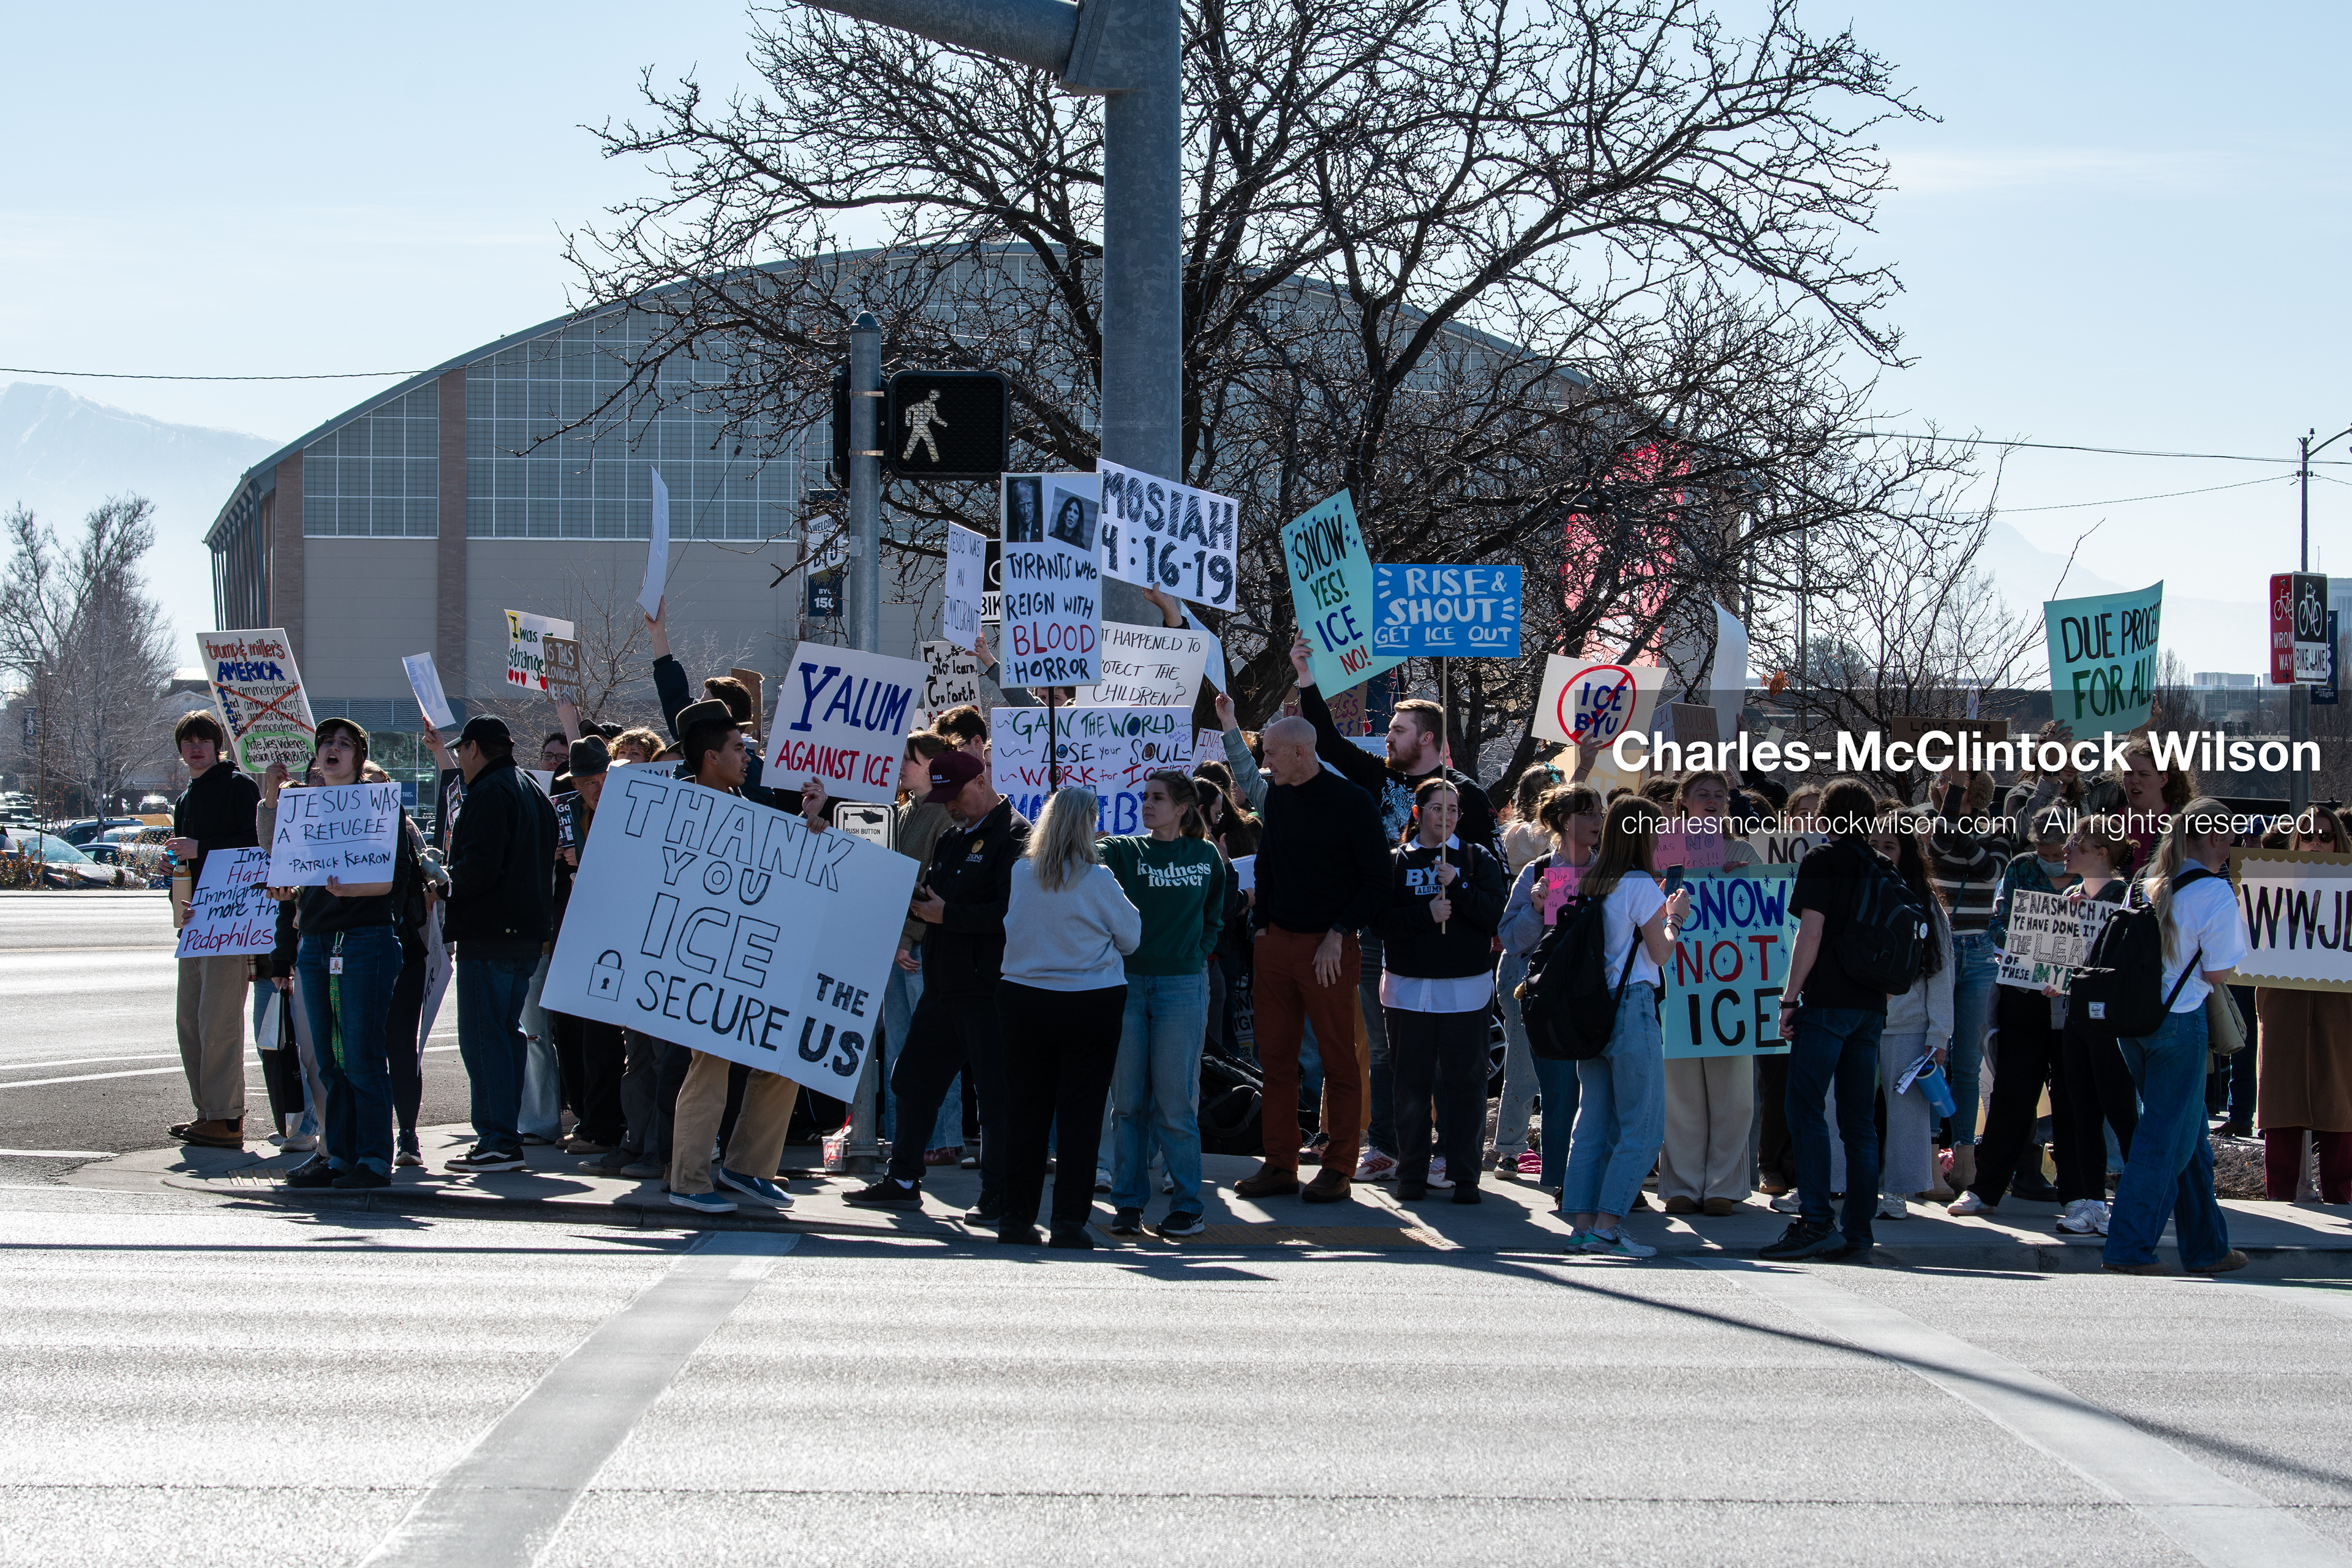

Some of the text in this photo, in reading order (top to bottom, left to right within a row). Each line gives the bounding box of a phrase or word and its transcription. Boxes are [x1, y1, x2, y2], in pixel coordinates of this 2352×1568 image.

[1102, 469, 1234, 550] MOSIAH
[949, 531, 981, 558] JESUS WAS
[1294, 513, 1347, 582] SNOW
[956, 568, 965, 587] AN
[1006, 552, 1098, 582] TYRANTS WHO
[1310, 568, 1349, 610] YES!
[1406, 567, 1507, 597] RISE &
[944, 595, 981, 636] IMMIGRANT
[982, 596, 1001, 616] BIK
[1005, 592, 1094, 621] REIGN WITH
[1384, 597, 1499, 625] SHOUT
[508, 614, 519, 639] I
[519, 627, 538, 643] was
[1012, 621, 1095, 656] BLOOD
[1113, 629, 1183, 650] HAPPENED
[1188, 637, 1201, 653] TO
[1314, 604, 1363, 652] ICE
[1374, 626, 1512, 645] GET ICE OUT
[2060, 612, 2116, 663] DUE
[2273, 631, 2293, 648] WRON
[205, 640, 238, 662] trump
[247, 639, 285, 660] miller's
[545, 643, 575, 666] IS THIS
[924, 646, 978, 675] Enter learn,
[1339, 644, 1372, 676] NO!
[2278, 654, 2293, 670] WAY
[2296, 648, 2309, 671] BIKE
[2311, 649, 2326, 672] LANE
[217, 661, 286, 682] AMERICA
[568, 668, 579, 684] OUR
[1014, 657, 1090, 684] HORROR
[1102, 658, 1180, 680] OTECT THE
[238, 680, 299, 698] ammendment
[790, 662, 913, 736] YALUM
[925, 674, 976, 707] Go Forth
[1580, 682, 1627, 711] ICE
[2072, 654, 2152, 720] FOR ALL
[244, 696, 304, 714] ammendment
[247, 710, 305, 726] ammendment
[1675, 707, 1712, 730] YOU CAN
[252, 721, 309, 736] ammendment
[1081, 712, 1107, 737] THE
[1108, 712, 1175, 739] WORLD
[1574, 710, 1618, 738] BYU
[1910, 721, 1991, 734] LOVE YOUR
[245, 751, 269, 763] division
[774, 739, 860, 781] AGAINST
[1041, 739, 1191, 765] LOSE your SOUL
[862, 753, 894, 788] ICE
[1019, 765, 1118, 786] WORK for
[284, 787, 399, 823] JESUS WAS
[277, 818, 388, 844] A REFUGEE
[625, 780, 854, 892] THANK
[1685, 834, 1714, 851] NO
[344, 850, 391, 867] KEARON
[1768, 837, 1810, 864] NO
[663, 846, 771, 906] YOU
[1137, 858, 1211, 879] kindness
[1148, 874, 1203, 887] forever
[1547, 870, 1570, 883] Due
[206, 902, 249, 921] more
[1680, 879, 1784, 932] SNOW
[2014, 891, 2097, 921] INASMUCH
[184, 918, 274, 952] Pedophiles
[2013, 914, 2026, 931] YE
[2026, 916, 2049, 932] HAVE
[2052, 919, 2079, 938] DONE
[2082, 924, 2097, 938] IT
[641, 892, 780, 989] ICE
[2009, 933, 2032, 953] THE
[1675, 935, 1778, 987] NOT
[2004, 955, 2019, 965] OF
[2001, 962, 2064, 986] THESE MY
[817, 973, 869, 1018] THE
[636, 970, 790, 1052] SECURE
[1687, 987, 1788, 1048] ICE
